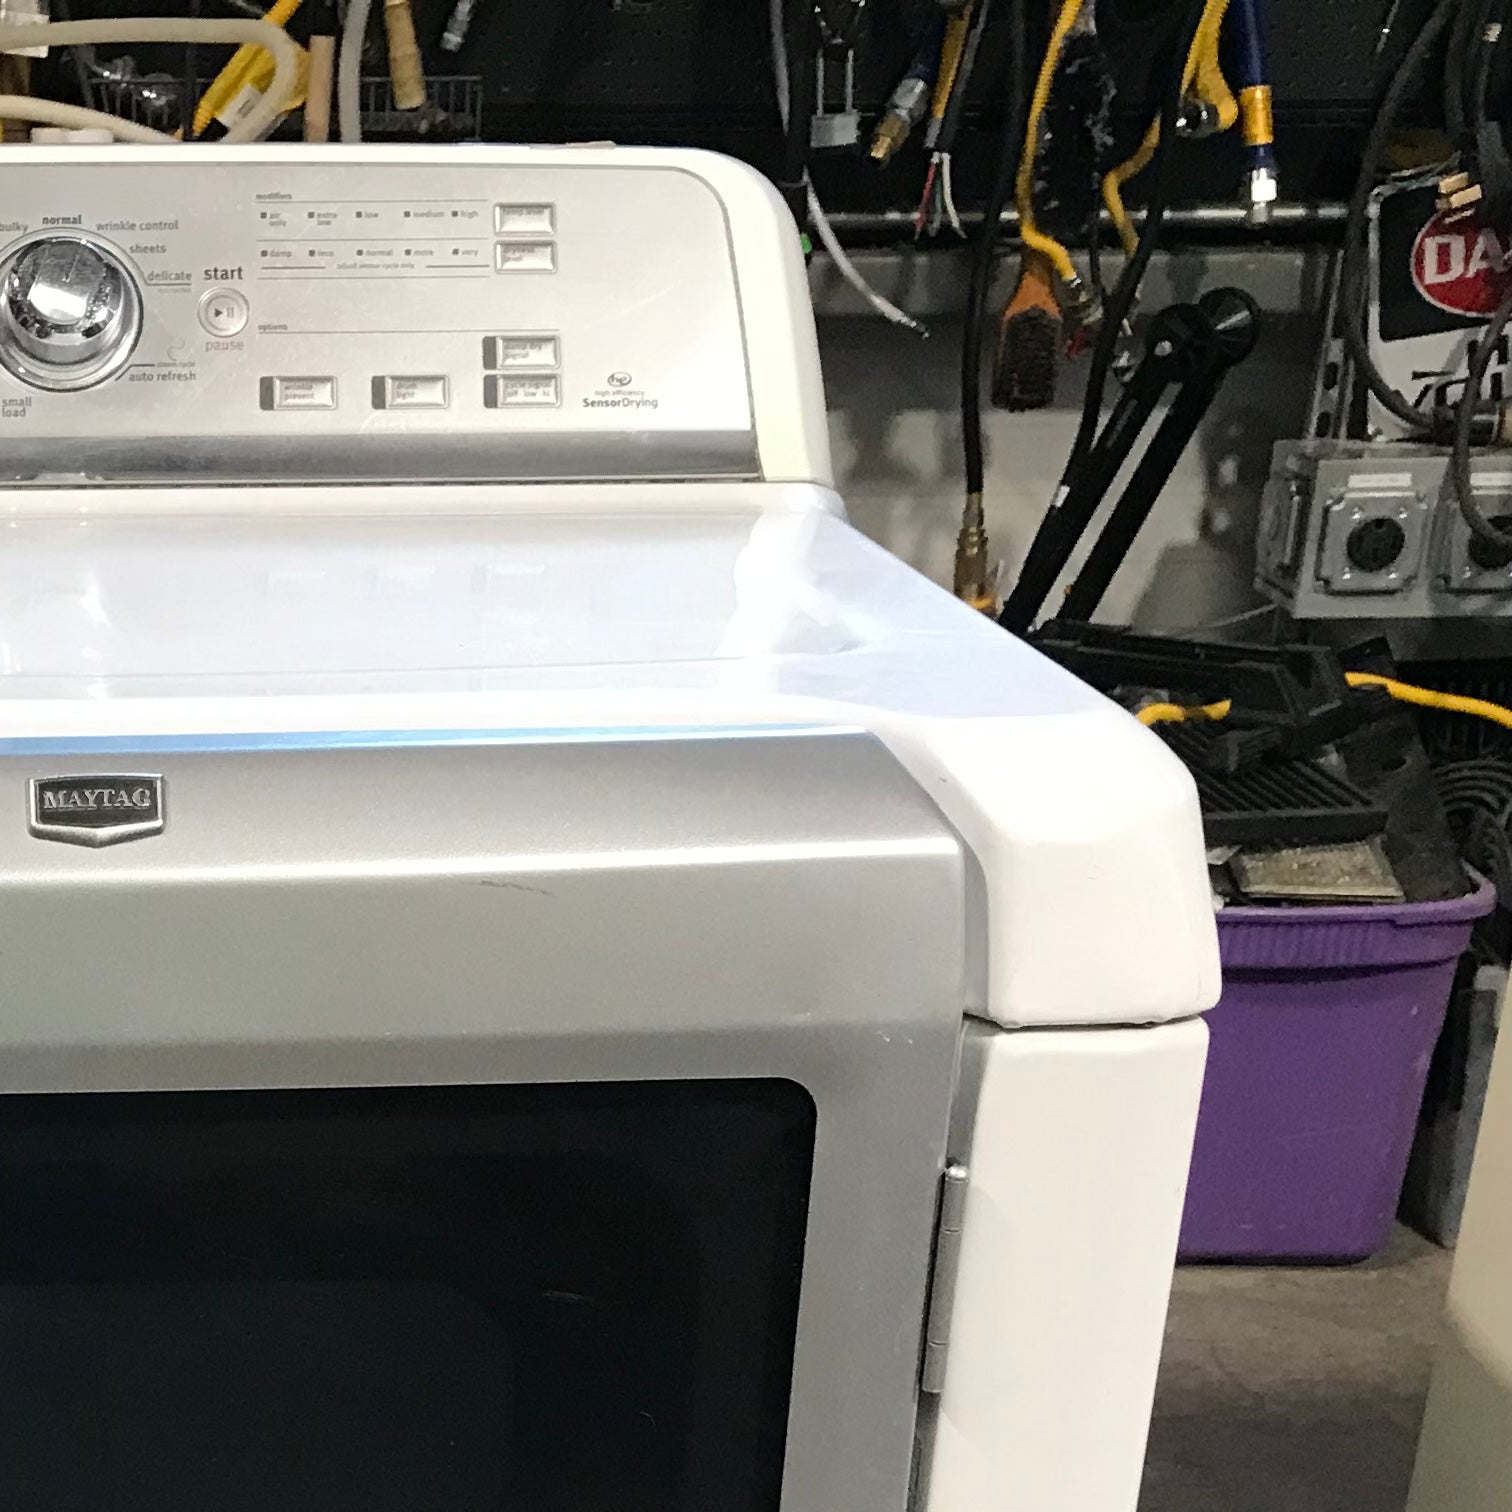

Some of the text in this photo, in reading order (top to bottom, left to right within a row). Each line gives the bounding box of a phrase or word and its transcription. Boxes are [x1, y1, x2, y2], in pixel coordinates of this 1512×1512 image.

[42, 214, 82, 225] normal
[96, 220, 178, 231] wrinkle control
[129, 243, 167, 254] sheets
[1424, 227, 1512, 286] DA
[147, 270, 192, 281] delicate
[204, 266, 243, 280] start
[205, 340, 244, 352] pause
[129, 371, 197, 382] auto refresh
[2, 397, 32, 407] small
[582, 397, 659, 409] SensorDrying
[2, 407, 26, 417] load
[43, 788, 151, 809] MAYTAG
